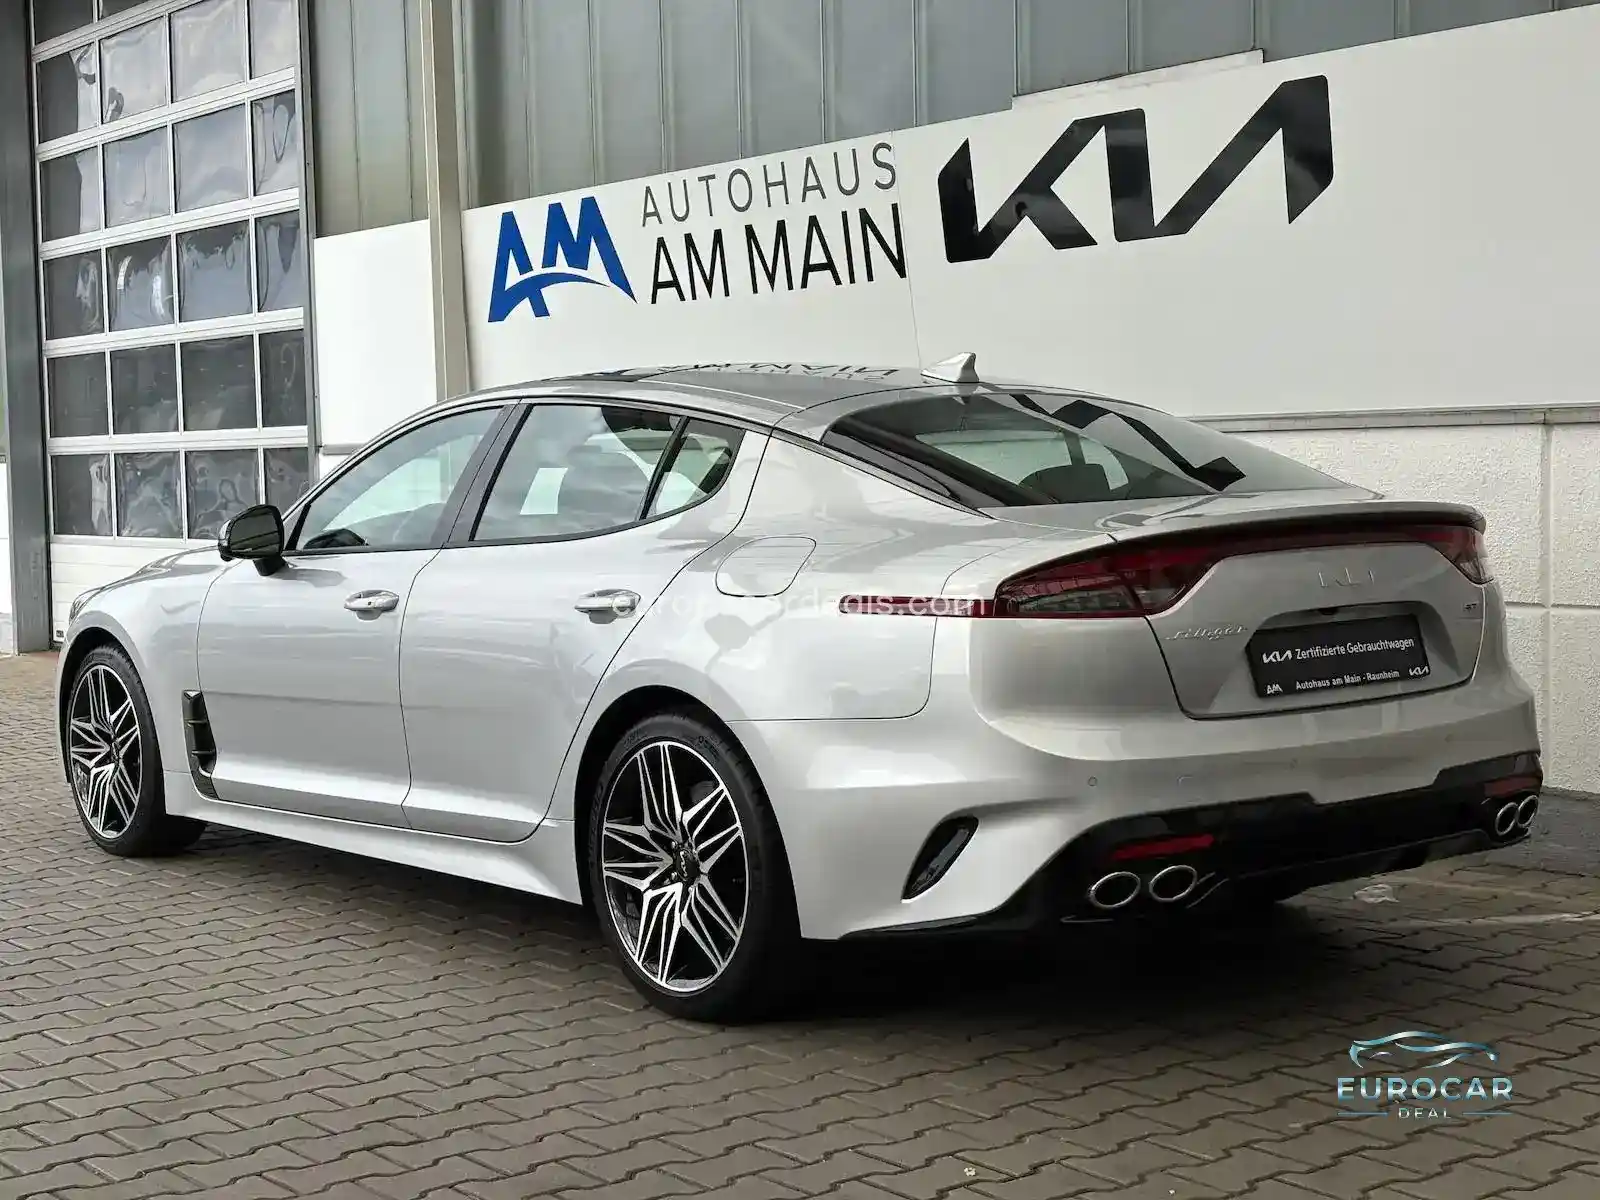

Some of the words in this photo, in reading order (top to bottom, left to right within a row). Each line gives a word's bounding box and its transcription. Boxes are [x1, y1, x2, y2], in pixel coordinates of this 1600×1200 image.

[641, 142, 897, 228] AUTOHAUS
[487, 196, 638, 323] AM
[650, 228, 731, 305] AM
[744, 202, 907, 295] MAIN
[1295, 644, 1346, 660] Zertifizierte
[1346, 638, 1415, 654] Gebrauchtwagen
[1295, 680, 1331, 690] Autohaus
[1332, 677, 1344, 686] am
[1343, 673, 1362, 684] Main
[1366, 669, 1400, 681] Raunheim
